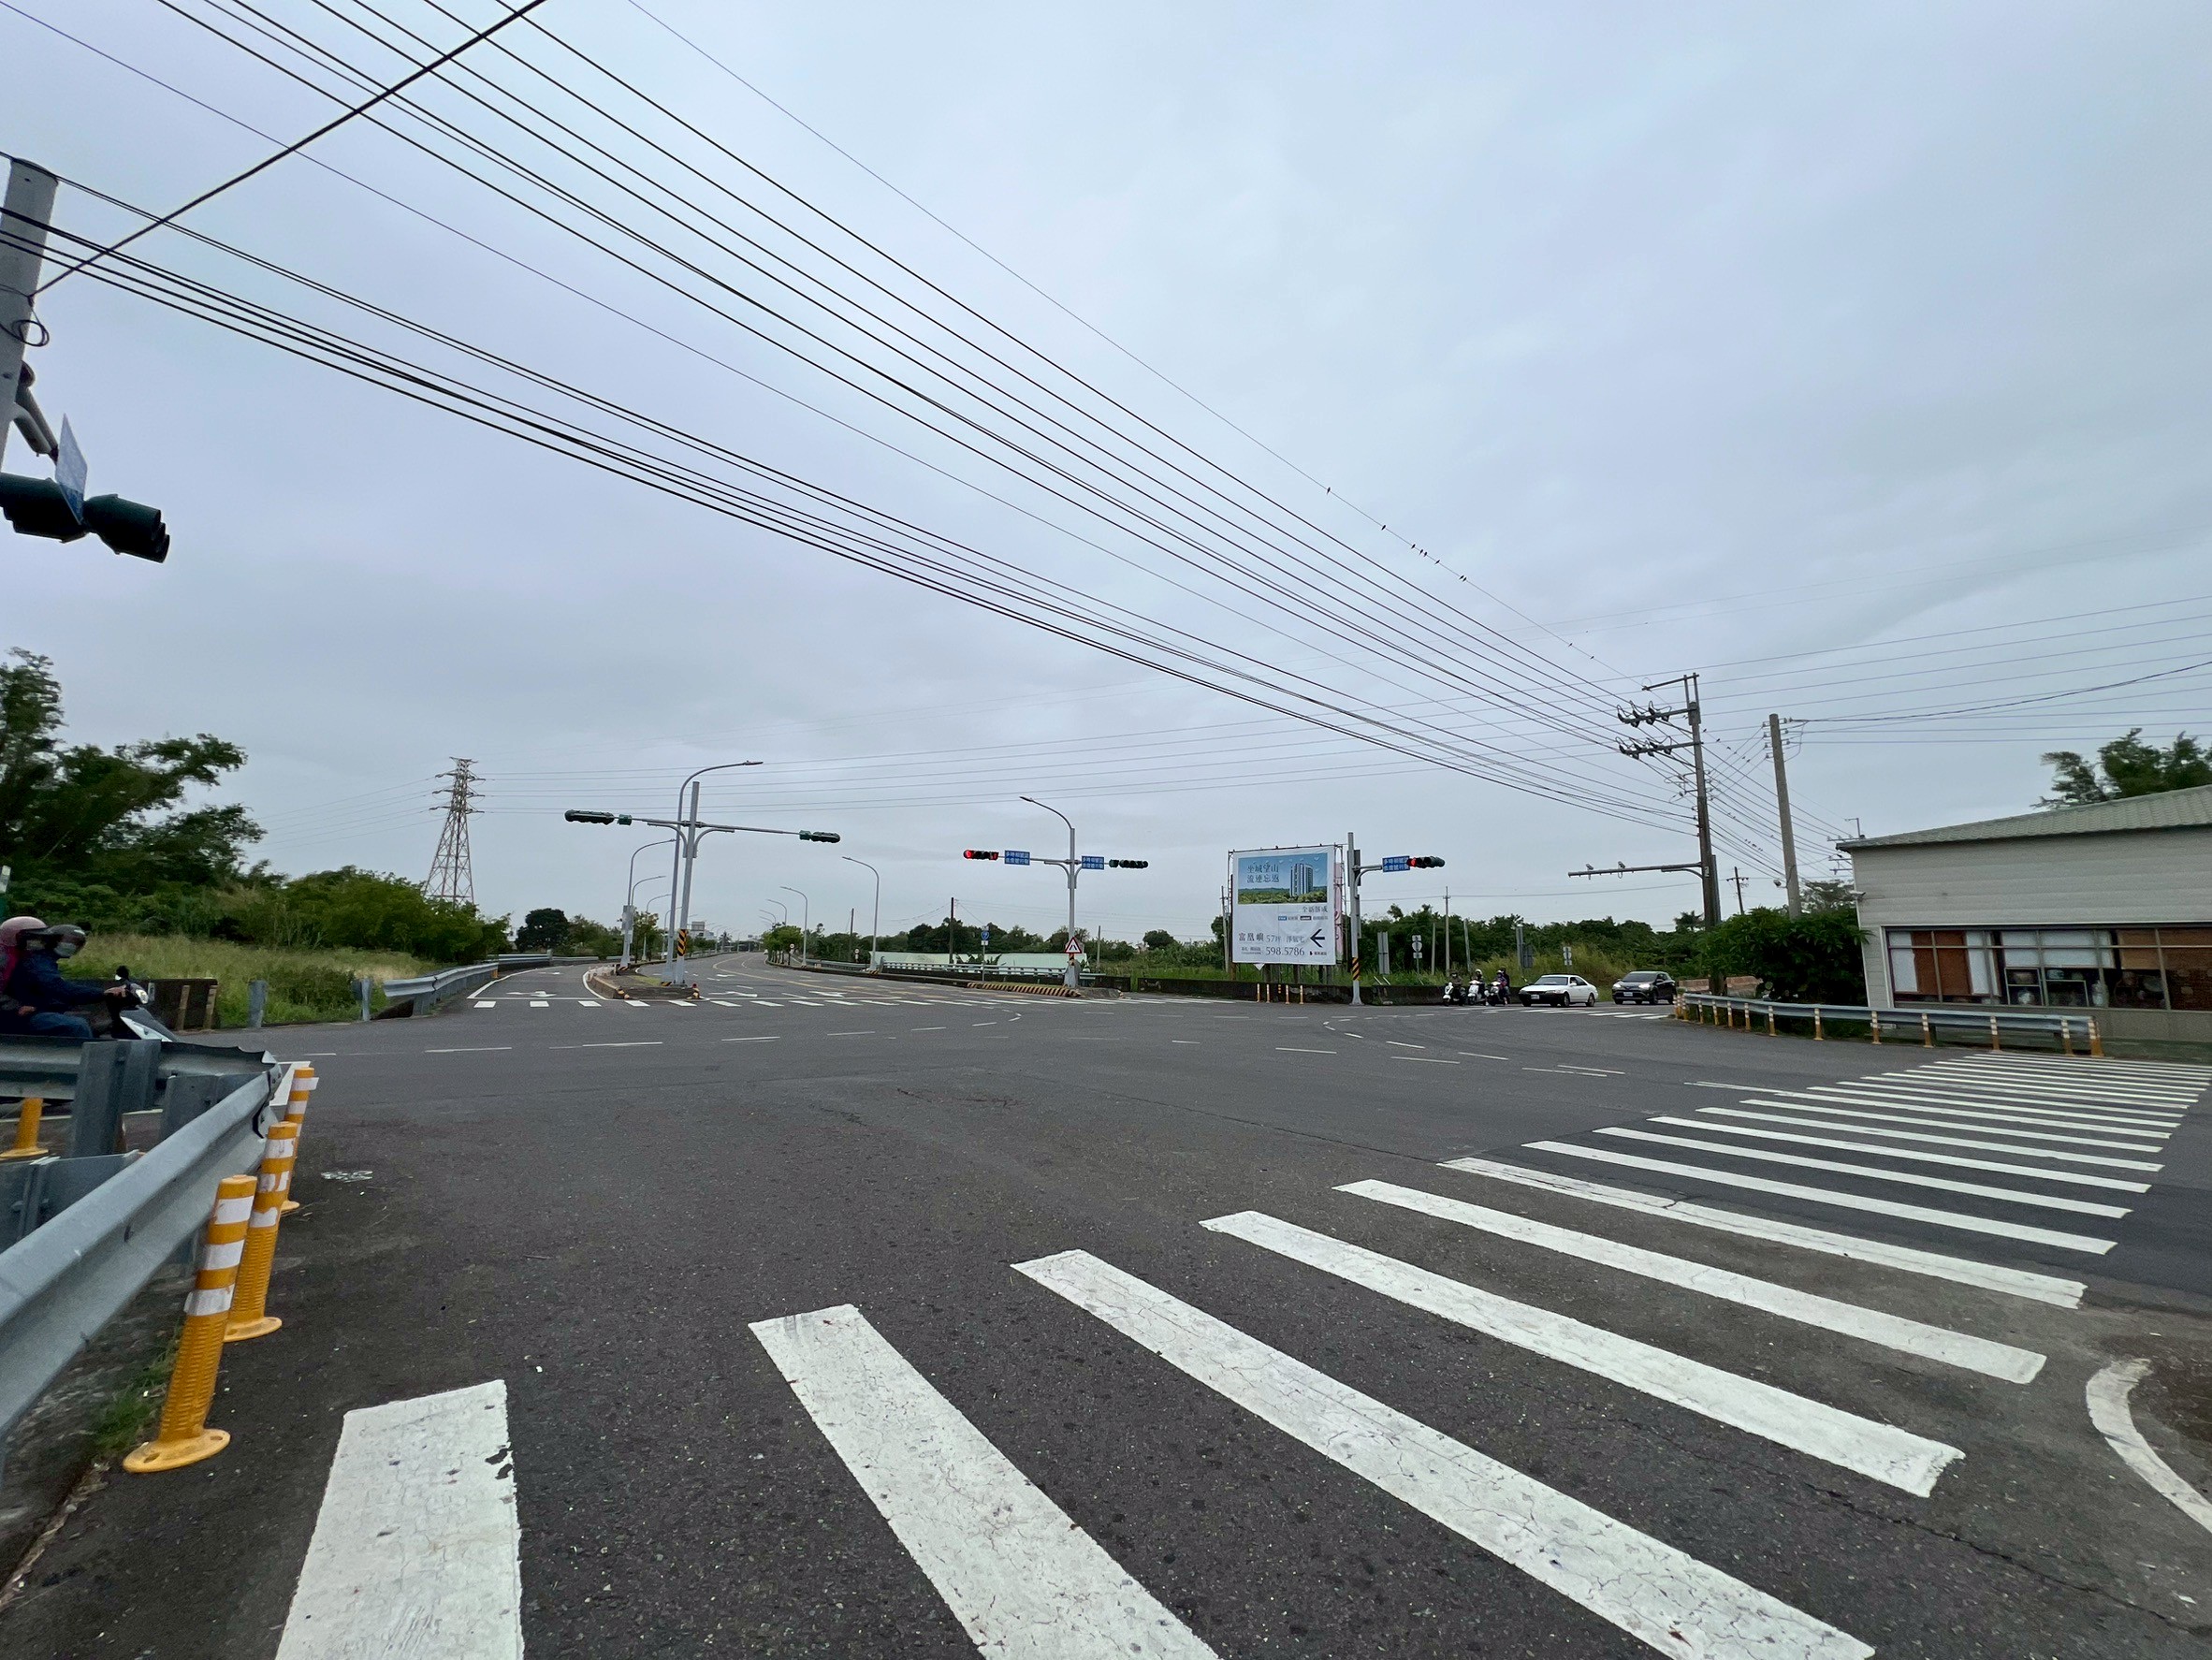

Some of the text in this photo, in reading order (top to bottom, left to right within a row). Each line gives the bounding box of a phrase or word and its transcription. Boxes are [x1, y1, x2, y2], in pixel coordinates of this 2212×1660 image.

[1247, 874, 1280, 883] 流連忘返
[1265, 946, 1304, 956] 598.5786
